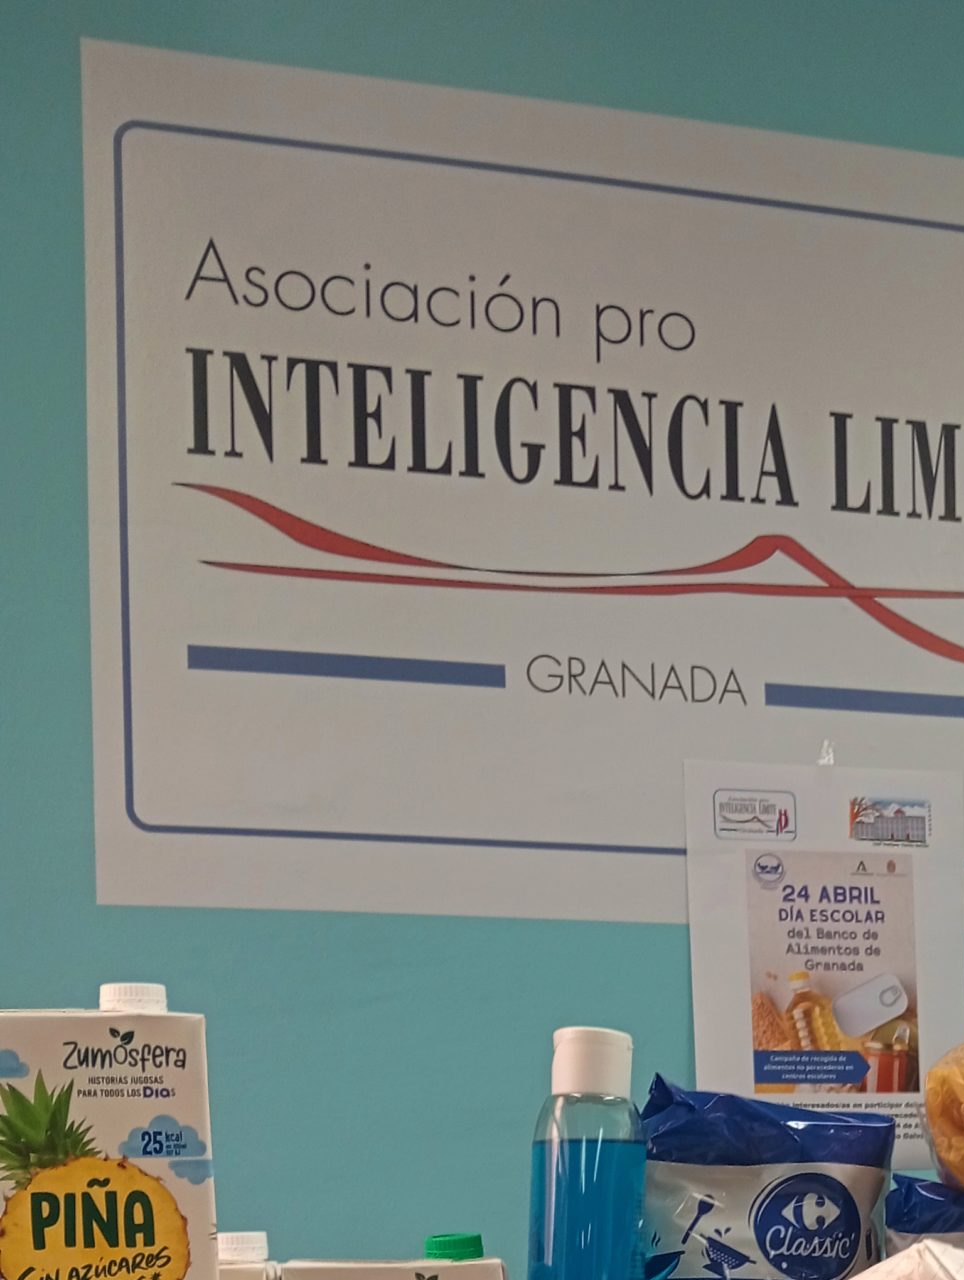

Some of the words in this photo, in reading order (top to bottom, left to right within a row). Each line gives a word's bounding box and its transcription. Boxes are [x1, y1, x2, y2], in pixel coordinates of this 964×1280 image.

[185, 237, 561, 338] Asociación
[595, 302, 696, 362] pro
[185, 347, 799, 507] INTELIGENCIA
[526, 655, 747, 706] GRANADA
[782, 885, 810, 903] 24
[818, 886, 880, 905] ABRIL
[778, 905, 804, 922] DÍA
[810, 909, 885, 924] ESCOLAR
[787, 928, 810, 939] del
[816, 928, 857, 940] Banco
[862, 929, 879, 941] de
[785, 943, 860, 956] Alimentos
[865, 945, 881, 956] de
[804, 959, 864, 972] Granada
[88, 1076, 128, 1085] HISTORIAS
[131, 1076, 164, 1085] JUGOSAS
[77, 1089, 97, 1098] PARA
[100, 1088, 124, 1097] TODOS
[127, 1088, 141, 1097] LOS
[141, 1131, 164, 1155] 25
[165, 1131, 182, 1142] kcal
[30, 1178, 156, 1250] PIÑA
